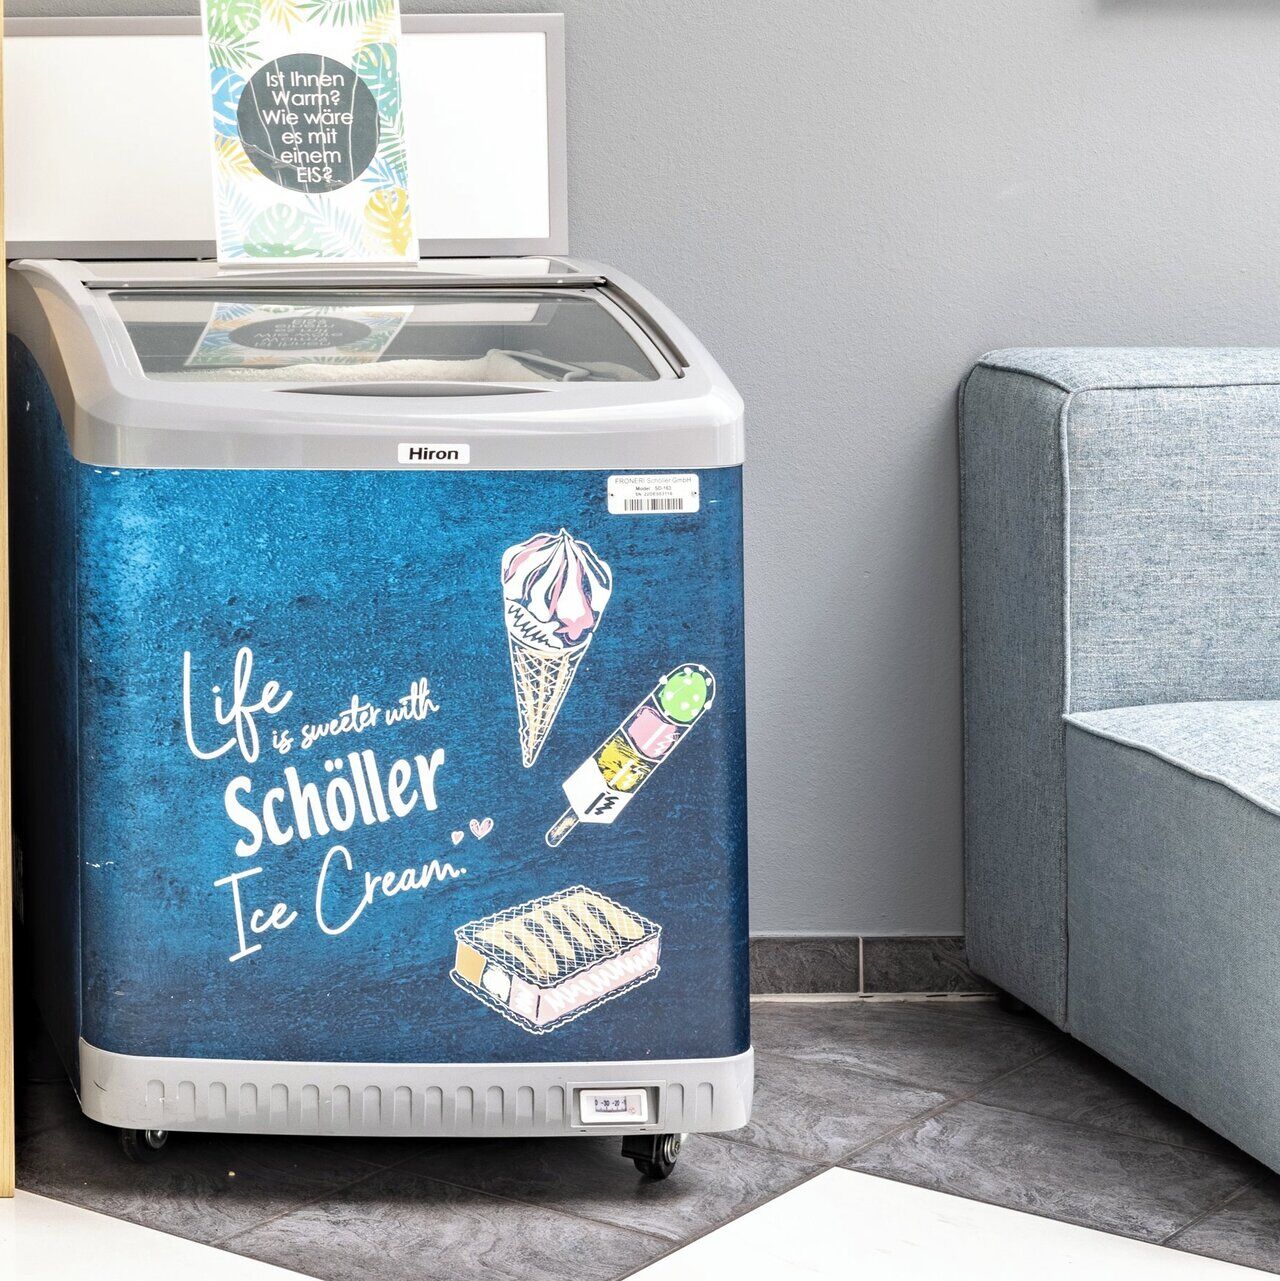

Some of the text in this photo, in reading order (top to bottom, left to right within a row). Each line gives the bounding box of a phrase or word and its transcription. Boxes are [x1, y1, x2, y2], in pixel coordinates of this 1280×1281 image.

[266, 72, 345, 87] Ist Ihnen
[273, 90, 340, 106] Warm?
[263, 109, 354, 125] Wie wäre
[282, 130, 337, 144] es mit
[280, 149, 341, 163] einem
[297, 166, 333, 183] EIS?
[408, 446, 459, 461] Hiron
[184, 647, 440, 763] Life is sweeter with
[224, 748, 445, 857] Schöller
[214, 845, 467, 963] Ice Cream.
